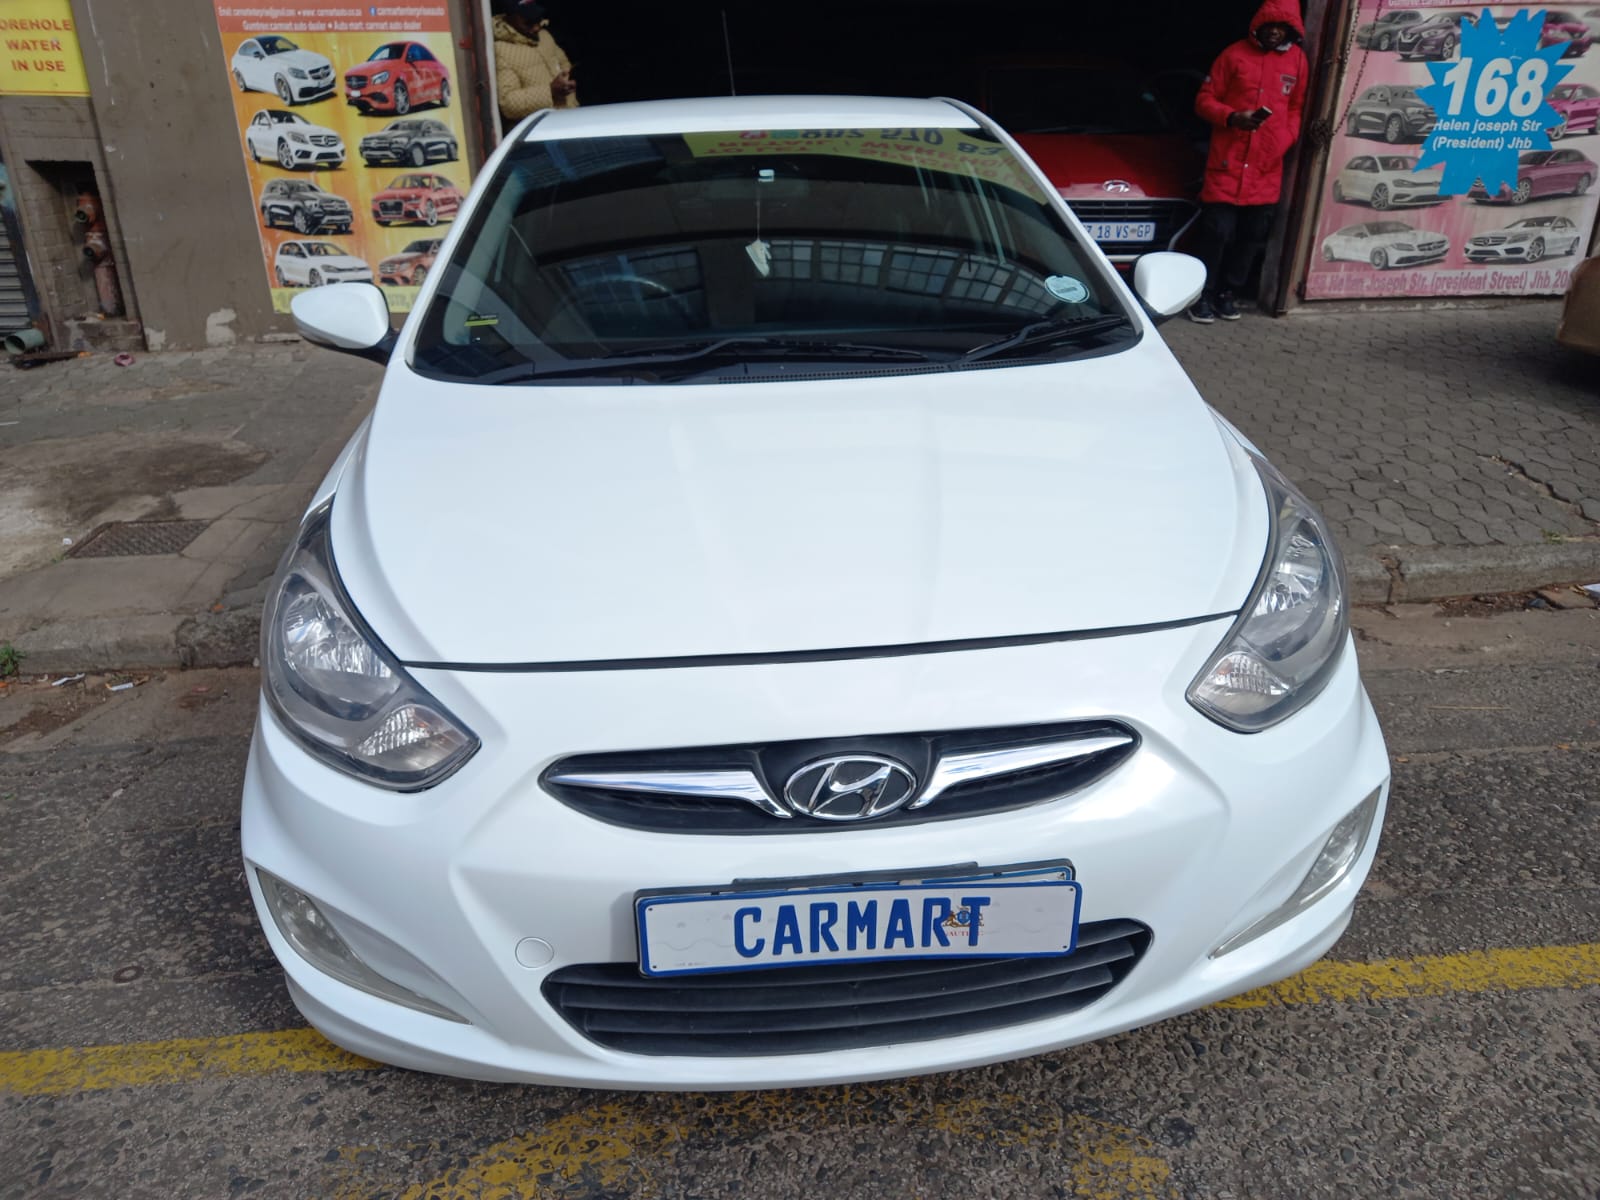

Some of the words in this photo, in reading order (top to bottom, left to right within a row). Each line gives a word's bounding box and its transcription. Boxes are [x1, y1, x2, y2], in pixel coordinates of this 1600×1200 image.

[6, 39, 62, 51] WATER
[11, 59, 29, 71] IN
[33, 59, 66, 72] USE
[1443, 57, 1548, 117] 168
[1471, 119, 1518, 134] joseph
[1432, 136, 1505, 151] (President)
[1507, 136, 1532, 149] Jhb
[1097, 224, 1111, 239] 18
[1431, 270, 1488, 292] (president
[1489, 270, 1528, 291] Street)
[1530, 270, 1550, 289] Jhb
[734, 896, 991, 958] CARMART
